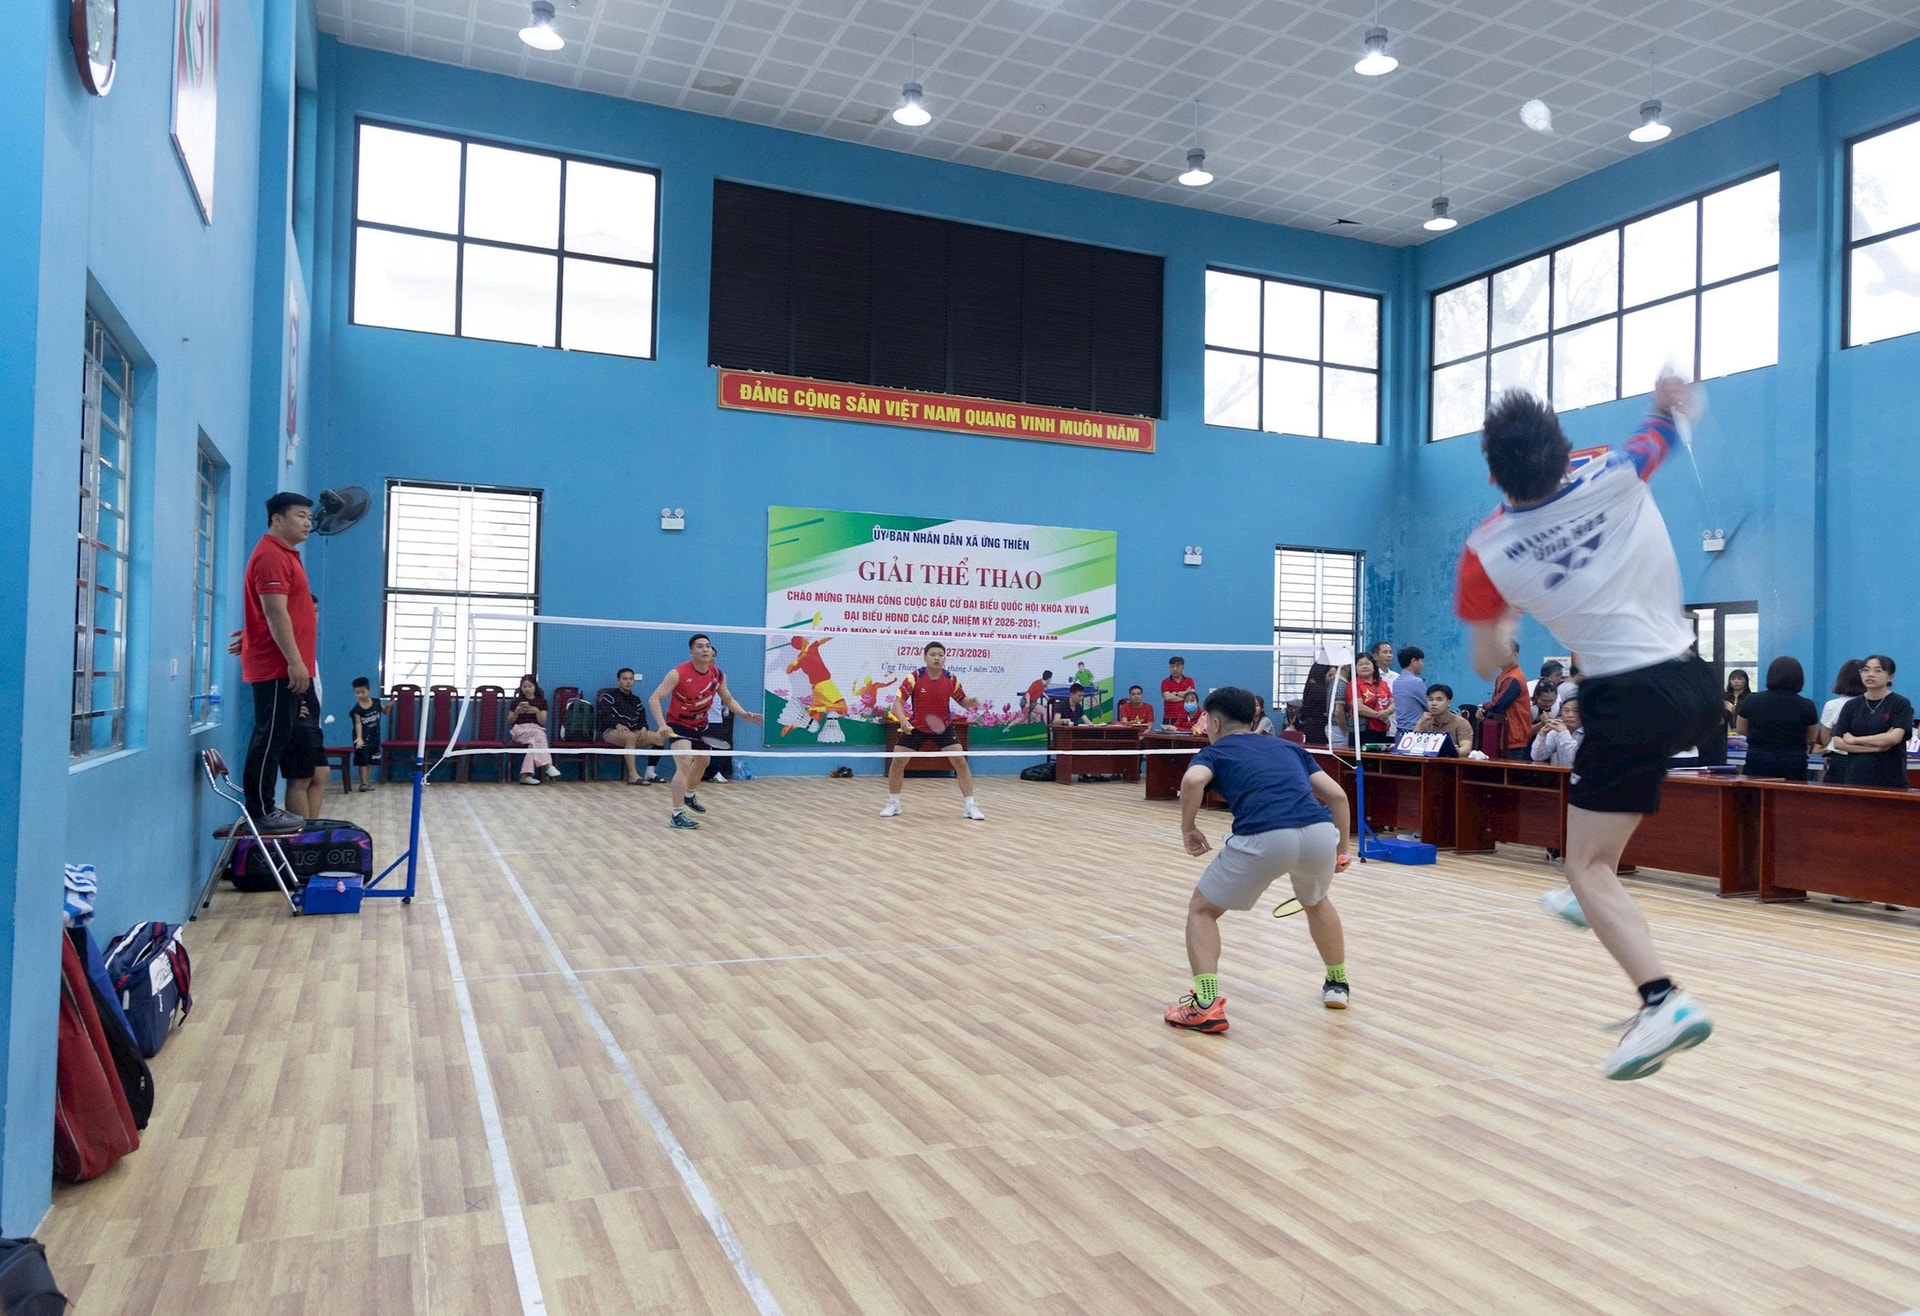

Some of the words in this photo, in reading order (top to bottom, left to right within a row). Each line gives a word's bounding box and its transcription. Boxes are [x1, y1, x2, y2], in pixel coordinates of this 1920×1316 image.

[740, 381, 788, 404] ĐẢNG
[794, 388, 841, 410] CỘNG
[846, 392, 880, 414] SẢN
[885, 399, 919, 421] VIỆT
[923, 404, 960, 423] NAM
[965, 409, 1016, 429] QUANG
[1020, 415, 1055, 433] VINH
[1060, 419, 1103, 438] MUÔN
[1107, 423, 1139, 442] NĂM
[874, 526, 887, 540] ỦY
[890, 531, 910, 542] BAN
[913, 532, 940, 545] NHÂN
[944, 533, 962, 546] DÂN
[966, 535, 978, 547] XÃ
[981, 536, 1000, 548] ỨNG
[1003, 538, 1030, 550] THIÊN
[859, 555, 912, 583] GIẢI
[920, 557, 970, 586] THỂ
[976, 568, 1042, 590] THAO
[787, 590, 812, 601] CHÀO
[815, 591, 842, 603] MỪNG
[846, 593, 874, 604] THÀNH
[877, 594, 902, 605] CÔNG
[904, 596, 927, 609] CUỘC
[950, 596, 961, 609] CỬ
[964, 599, 977, 611] ĐẠI
[1001, 599, 1022, 612] QUỐC
[1025, 601, 1038, 613] HỘI
[1041, 601, 1062, 613] KHÓA
[1064, 605, 1076, 614] XVI
[1079, 604, 1089, 614] VÀ
[844, 610, 859, 622] ĐẠI
[886, 612, 909, 623] HĐND
[912, 612, 929, 624] CÁC
[952, 614, 980, 627] NHIỆM
[995, 618, 1040, 629] 2026-2031;
[946, 648, 990, 658] 27/3/2026)
[968, 665, 972, 673] 3
[989, 665, 1005, 673] 2026
[1401, 736, 1413, 749] 0
